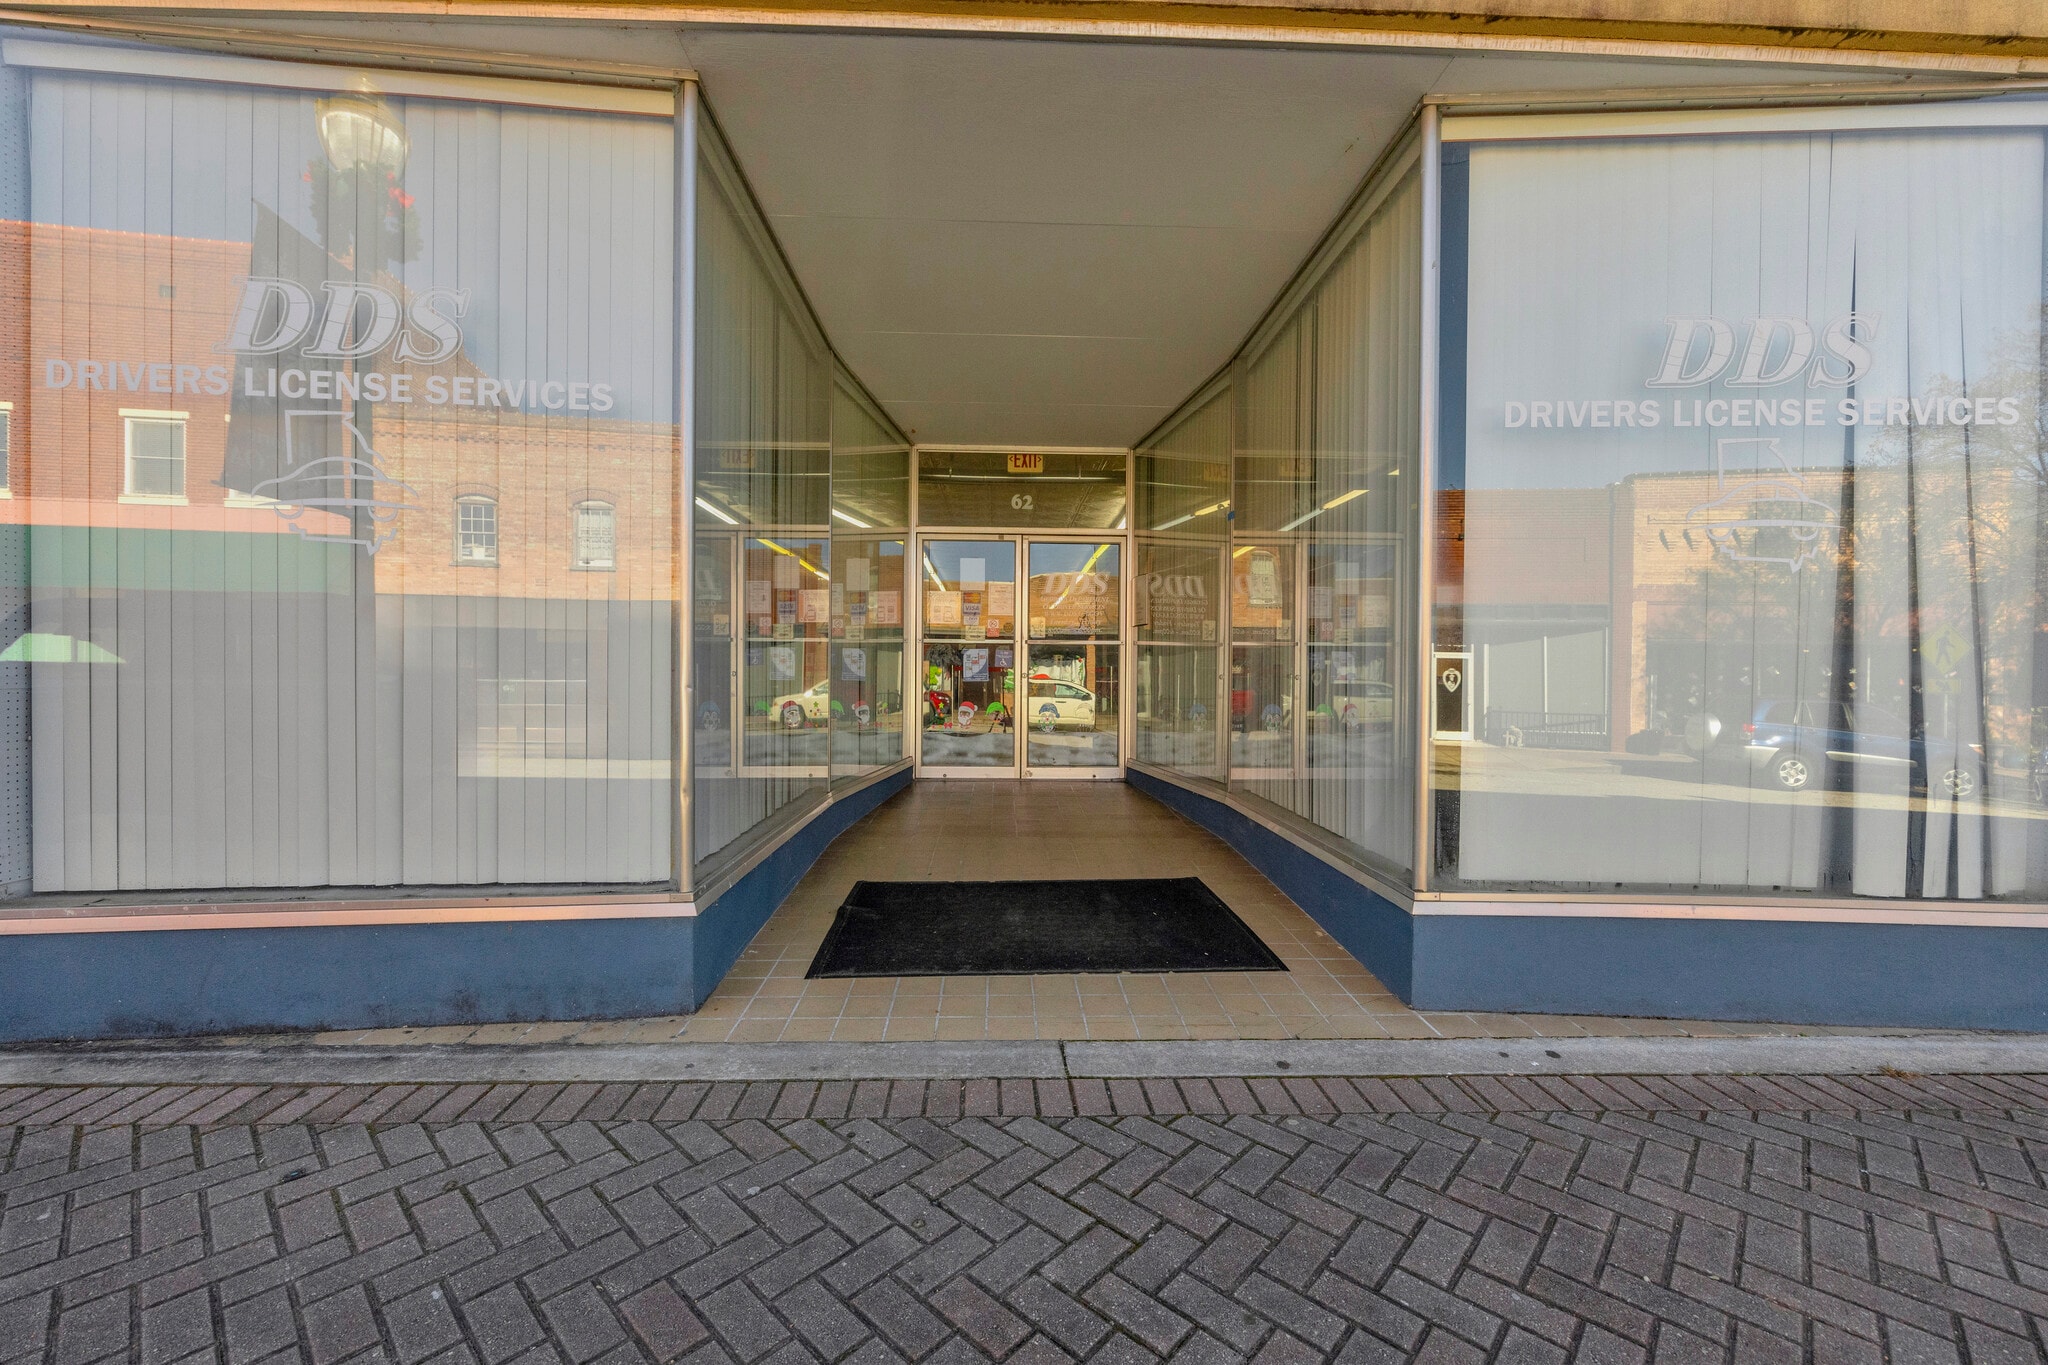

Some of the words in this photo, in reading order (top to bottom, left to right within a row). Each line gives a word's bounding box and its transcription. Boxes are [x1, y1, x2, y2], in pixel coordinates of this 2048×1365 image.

[214, 276, 471, 364] DDS
[1645, 312, 1881, 388] DDS
[45, 358, 229, 396] DRIVERS
[243, 368, 413, 402] LICENSE
[425, 376, 614, 411] SERVICES
[1504, 400, 1660, 428] DRIVERS
[1673, 399, 1825, 427] LICENSE
[1837, 397, 2020, 426] SERVICES
[1014, 454, 1037, 468] EXIT
[1011, 494, 1033, 509] 62
[1041, 573, 1109, 595] DDS
